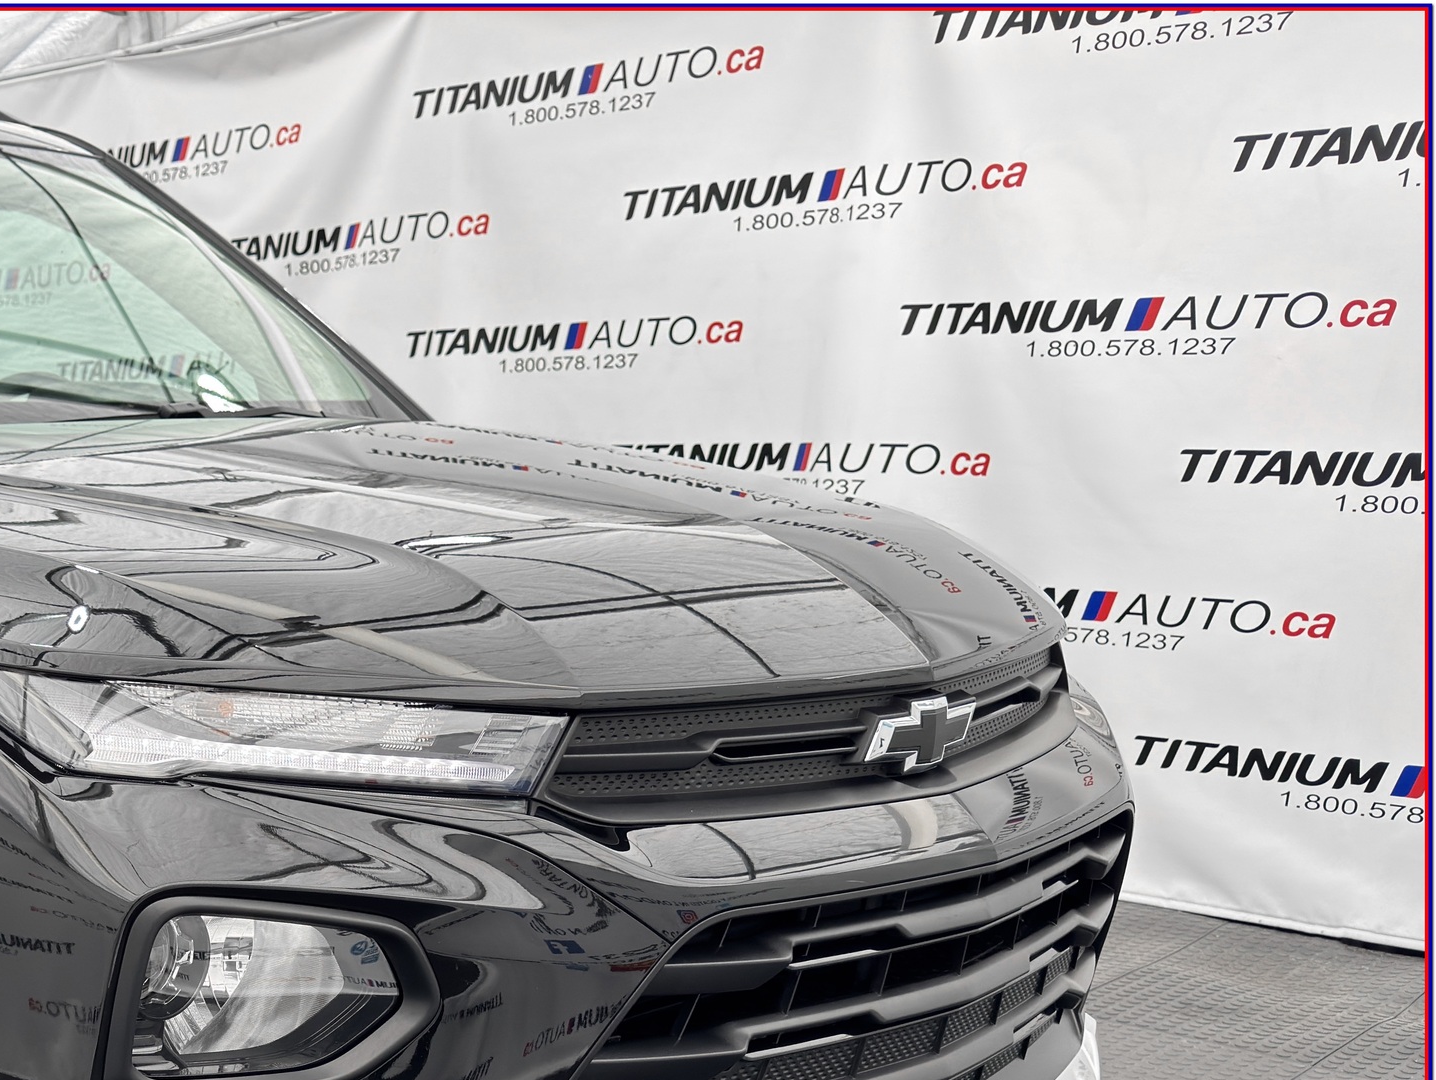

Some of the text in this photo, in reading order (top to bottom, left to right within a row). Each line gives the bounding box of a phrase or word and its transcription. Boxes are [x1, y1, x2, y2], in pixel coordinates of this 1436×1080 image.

[1071, 11, 1295, 54] 1.800.578.1237
[413, 45, 765, 119] TITANIUM AUTO.ca
[508, 92, 657, 127] 1.800.578.1237
[190, 123, 302, 160] AUTO.ca
[1233, 121, 1425, 173] TITANI
[623, 158, 1028, 221] TITANIUM AUTO.ca
[358, 211, 490, 249] AUTO.ca
[733, 202, 903, 232] 1.800.578.1237
[284, 247, 401, 277] 1.800.578.1237
[899, 291, 1398, 335] TITANIUM AUTO.ca
[407, 315, 743, 358] TITANIUM AUTO.ca
[1025, 337, 1237, 358] 1.800.578.1237
[499, 353, 639, 374] 1.800.578.1237
[809, 443, 991, 476] AUTO.ca
[1115, 593, 1337, 639] AUTO.ca
[1134, 735, 1390, 793] TITANIUM
